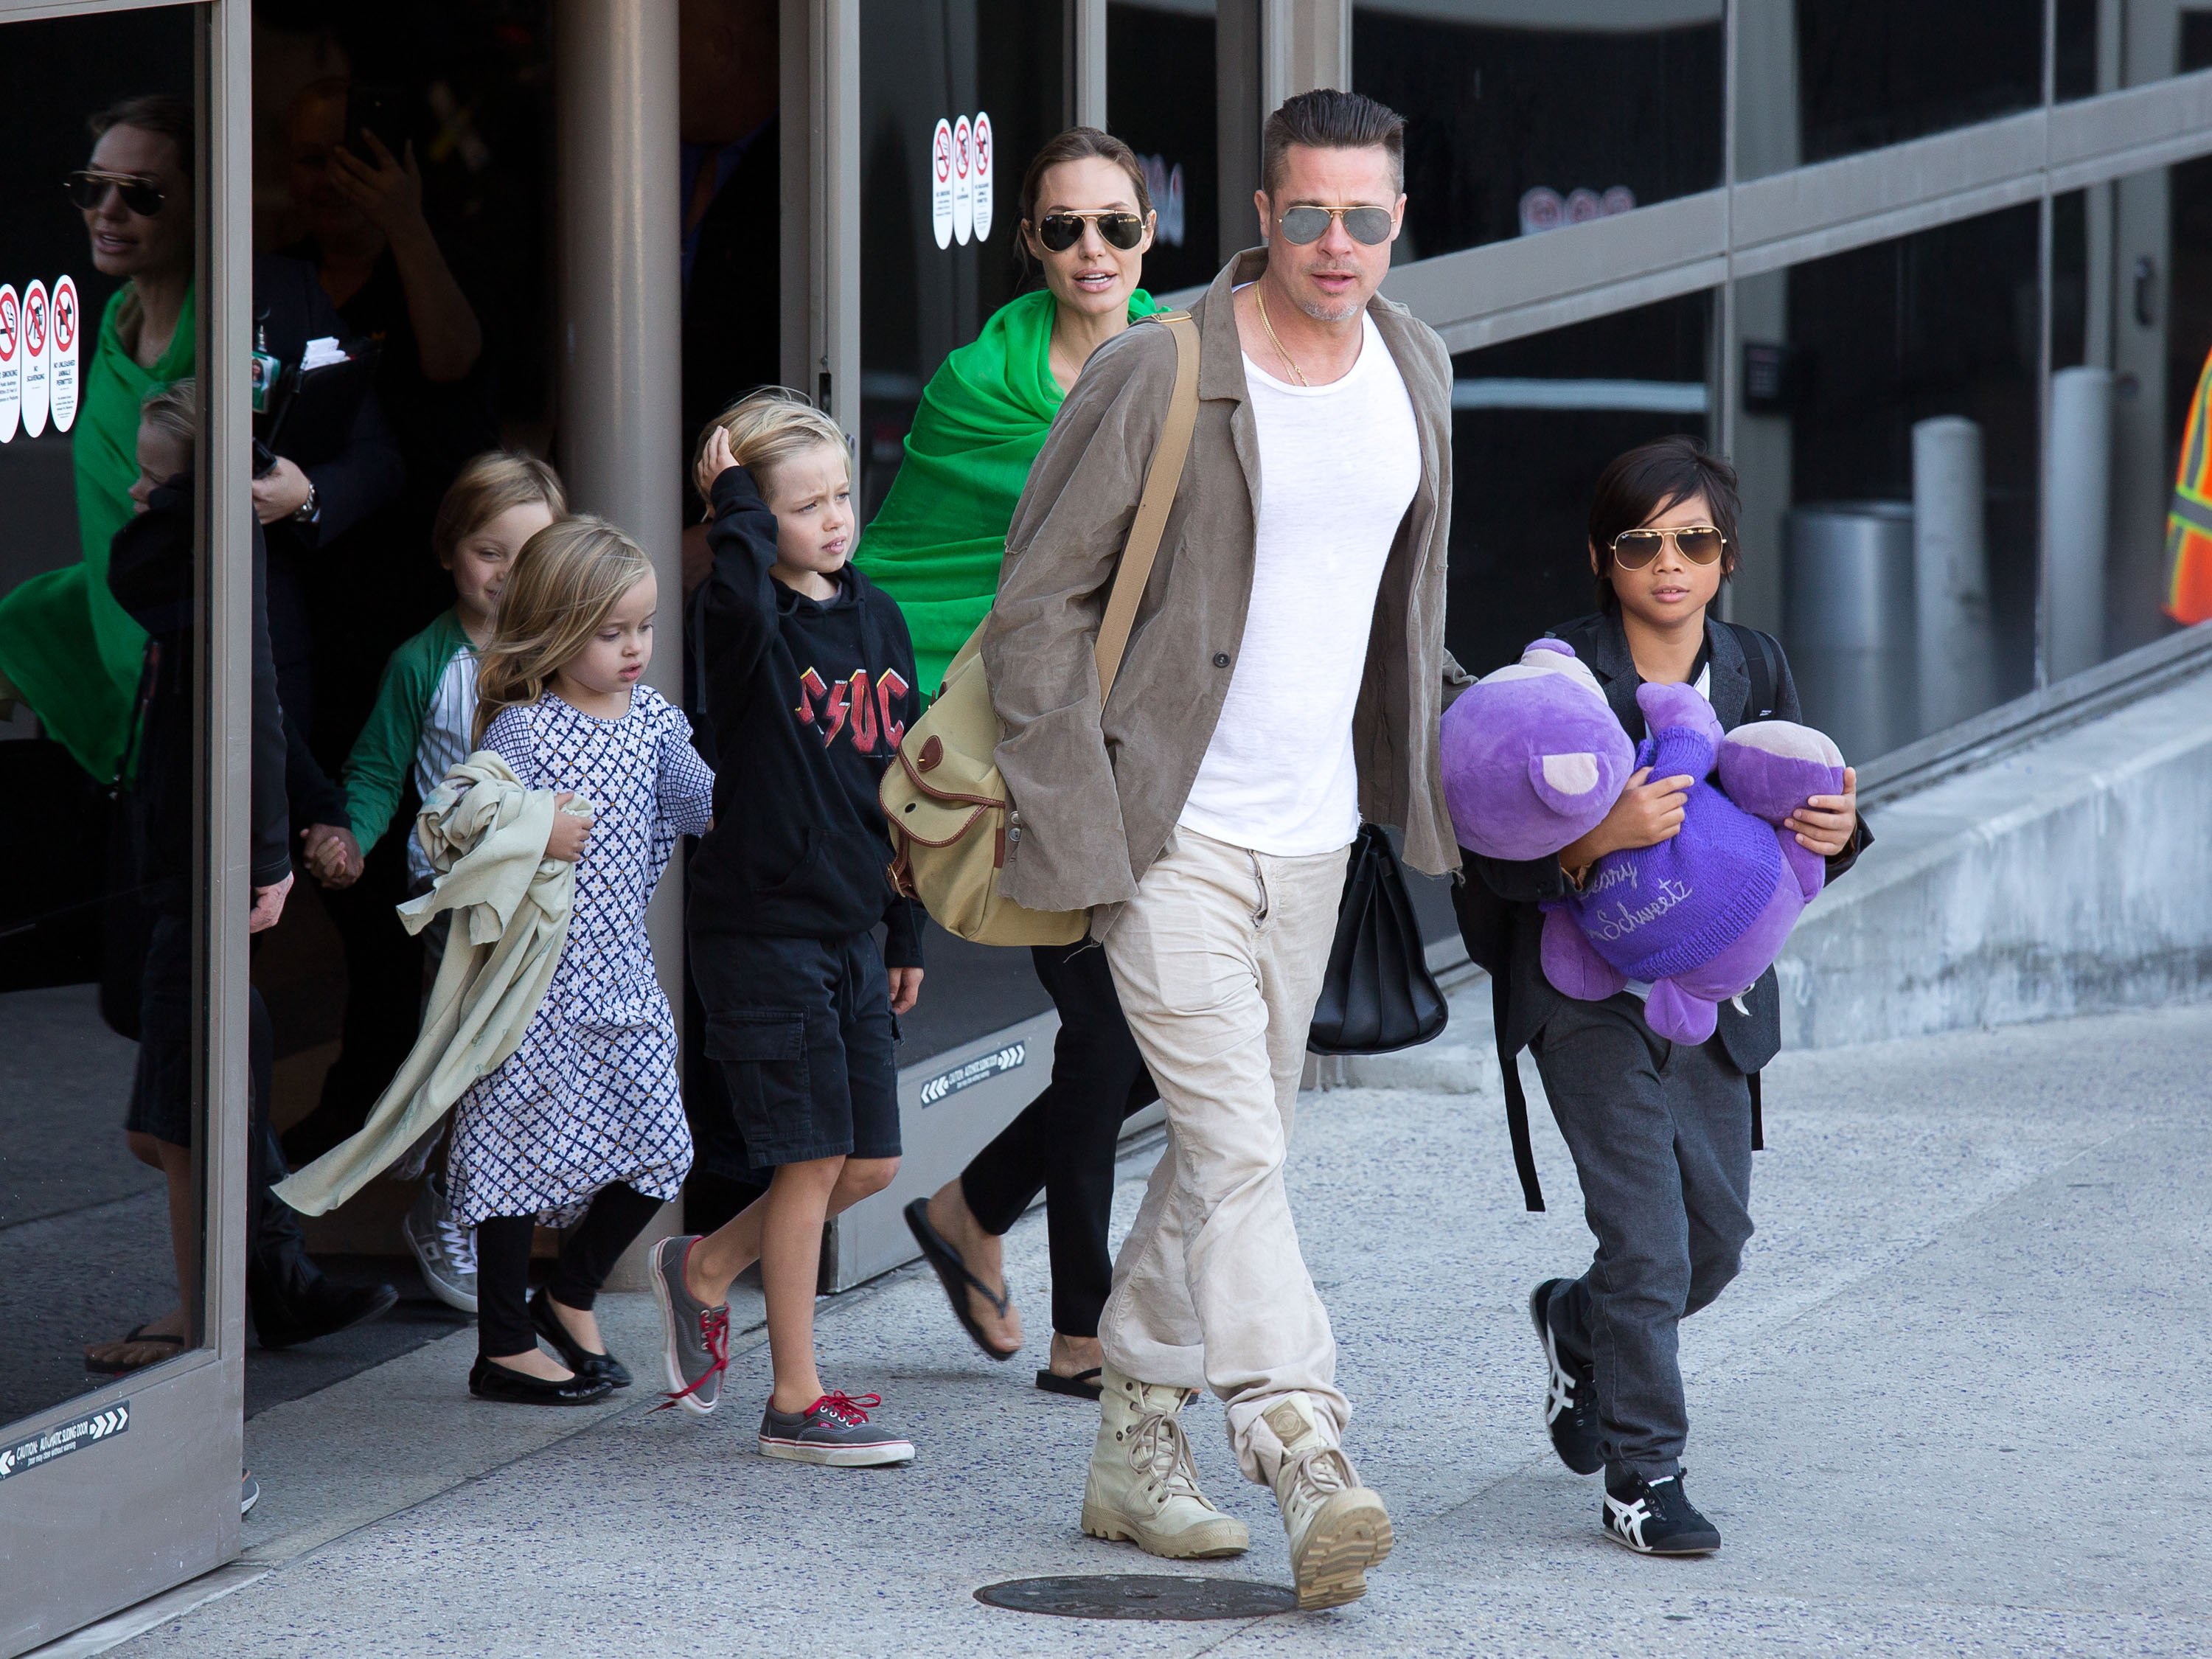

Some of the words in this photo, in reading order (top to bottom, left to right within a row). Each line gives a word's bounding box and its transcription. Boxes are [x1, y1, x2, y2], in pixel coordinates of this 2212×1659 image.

[795, 666, 910, 754] C/DC
[1585, 862, 1638, 897] eary
[62, 1425, 77, 1442] SLIDING
[77, 1422, 88, 1437] DOOR
